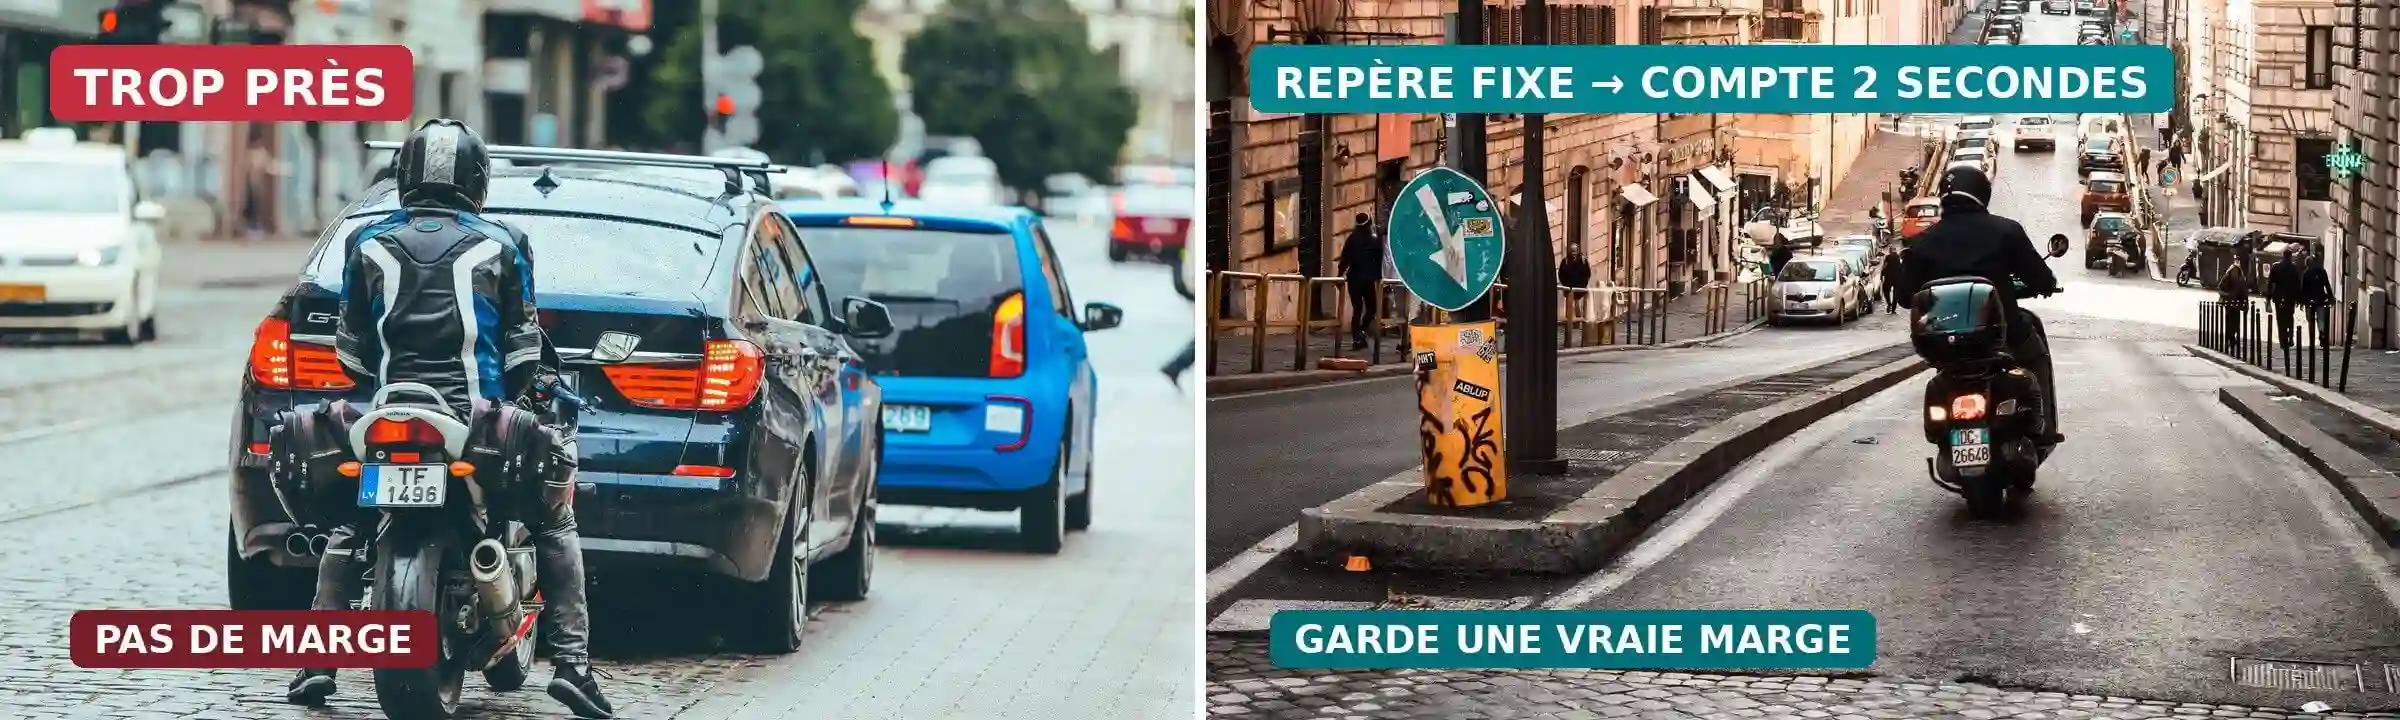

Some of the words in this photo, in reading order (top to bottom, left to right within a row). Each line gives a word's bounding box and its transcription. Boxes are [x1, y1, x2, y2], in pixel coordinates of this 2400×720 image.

[1455, 381, 1488, 398] ABLUP
[398, 467, 428, 486] TF
[362, 491, 375, 500] LV
[387, 485, 438, 503] 1496
